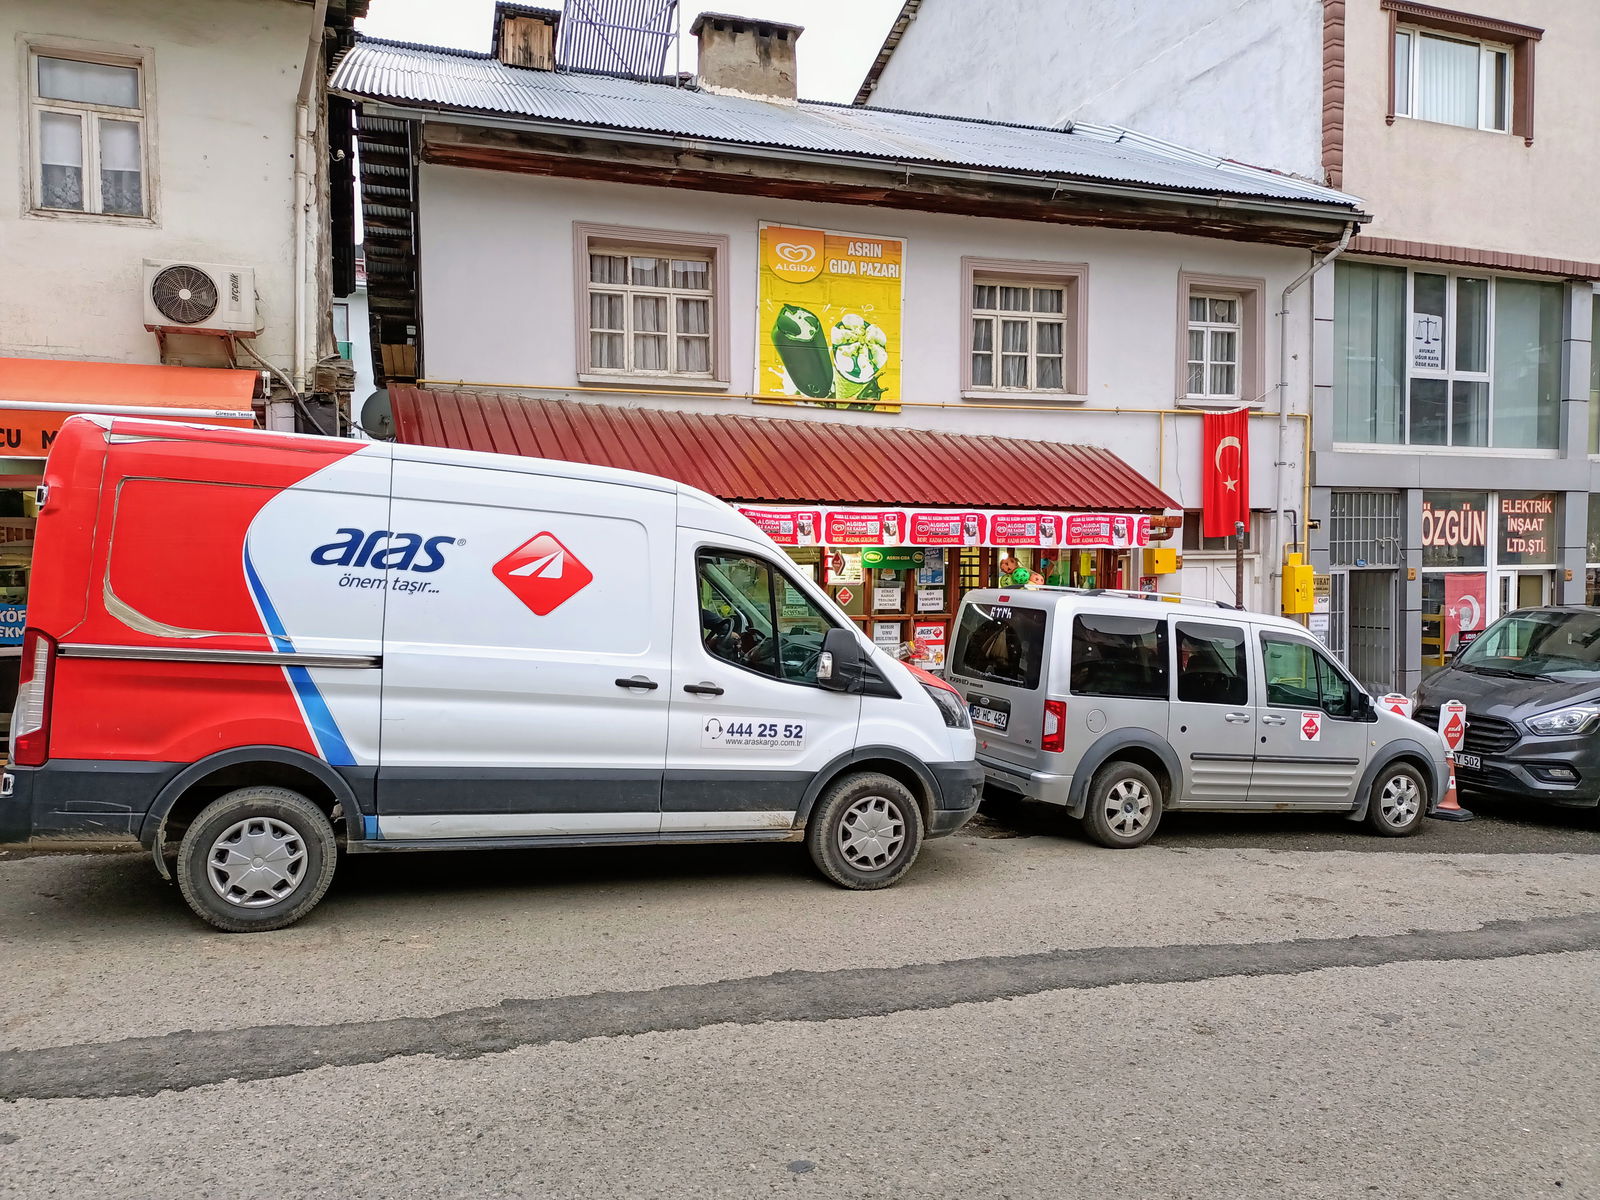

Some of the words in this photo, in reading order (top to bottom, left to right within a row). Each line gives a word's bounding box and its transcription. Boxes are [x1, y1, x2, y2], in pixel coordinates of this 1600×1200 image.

[848, 242, 882, 258] ASRIN
[829, 259, 857, 275] GIDA
[860, 261, 899, 278] PAZARI
[231, 272, 239, 302] arçelik
[1501, 497, 1552, 514] ELEKTRİK
[1421, 501, 1486, 546] ÖZGÜN
[1507, 515, 1544, 535] İNŞAAT
[310, 528, 455, 573] aras
[1506, 537, 1546, 555] LTD.ŞTİ.
[338, 573, 387, 590] önem
[982, 708, 992, 721] HC
[726, 722, 753, 737] 444
[757, 723, 778, 738] 25
[783, 724, 803, 739] 52
[725, 738, 802, 747] www.araskargo.com.tr
[1464, 755, 1480, 768] 502
